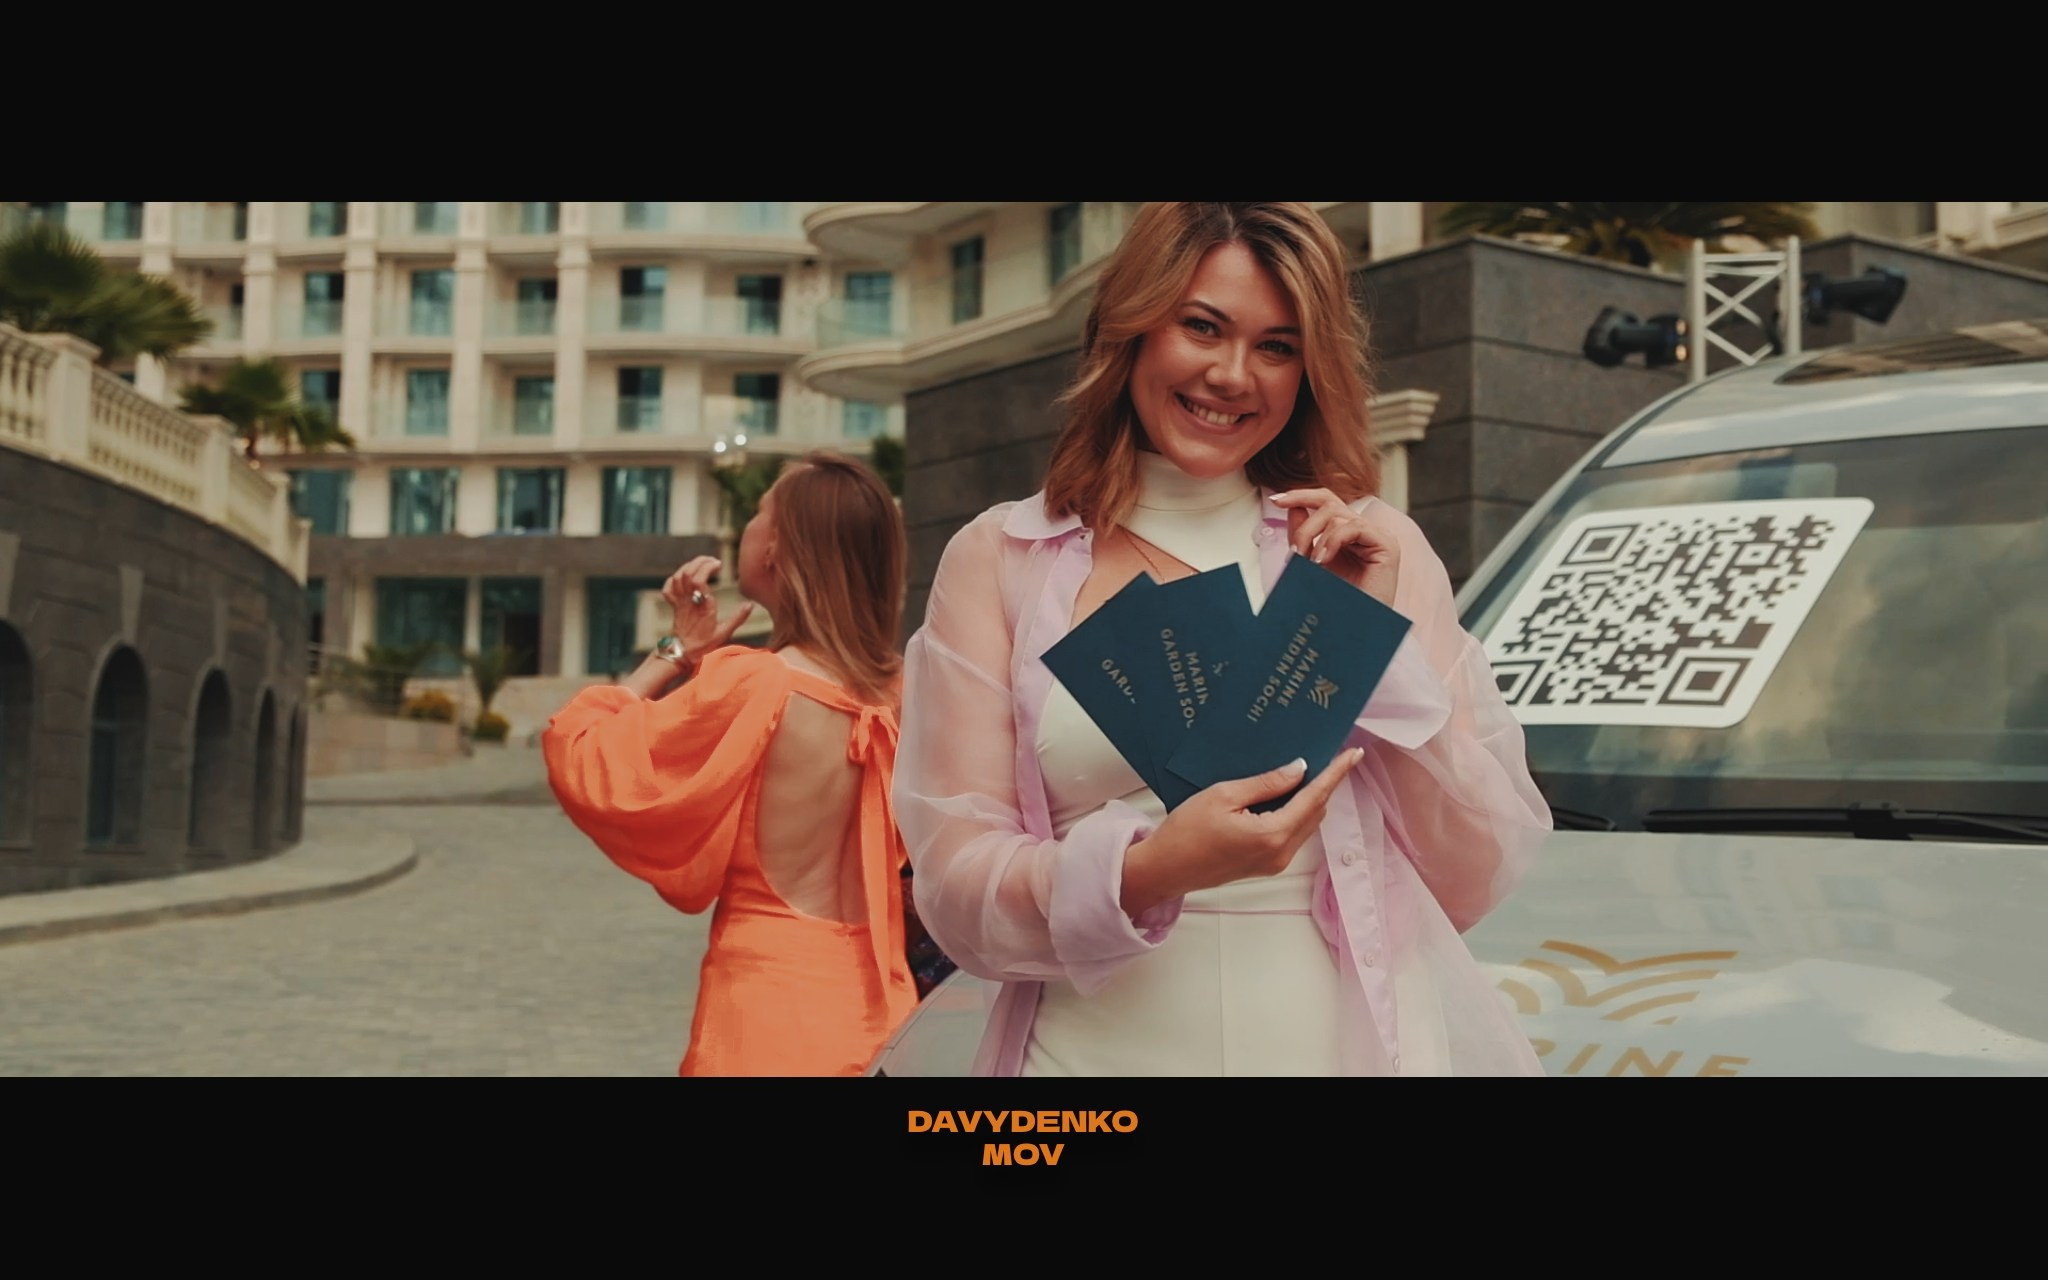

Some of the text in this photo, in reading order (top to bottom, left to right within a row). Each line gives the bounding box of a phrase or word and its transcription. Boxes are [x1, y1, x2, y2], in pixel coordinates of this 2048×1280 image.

[1160, 628, 1189, 693] GARDEN
[1246, 613, 1319, 722] GARDEN SOCHI
[1277, 647, 1319, 708] MARINE
